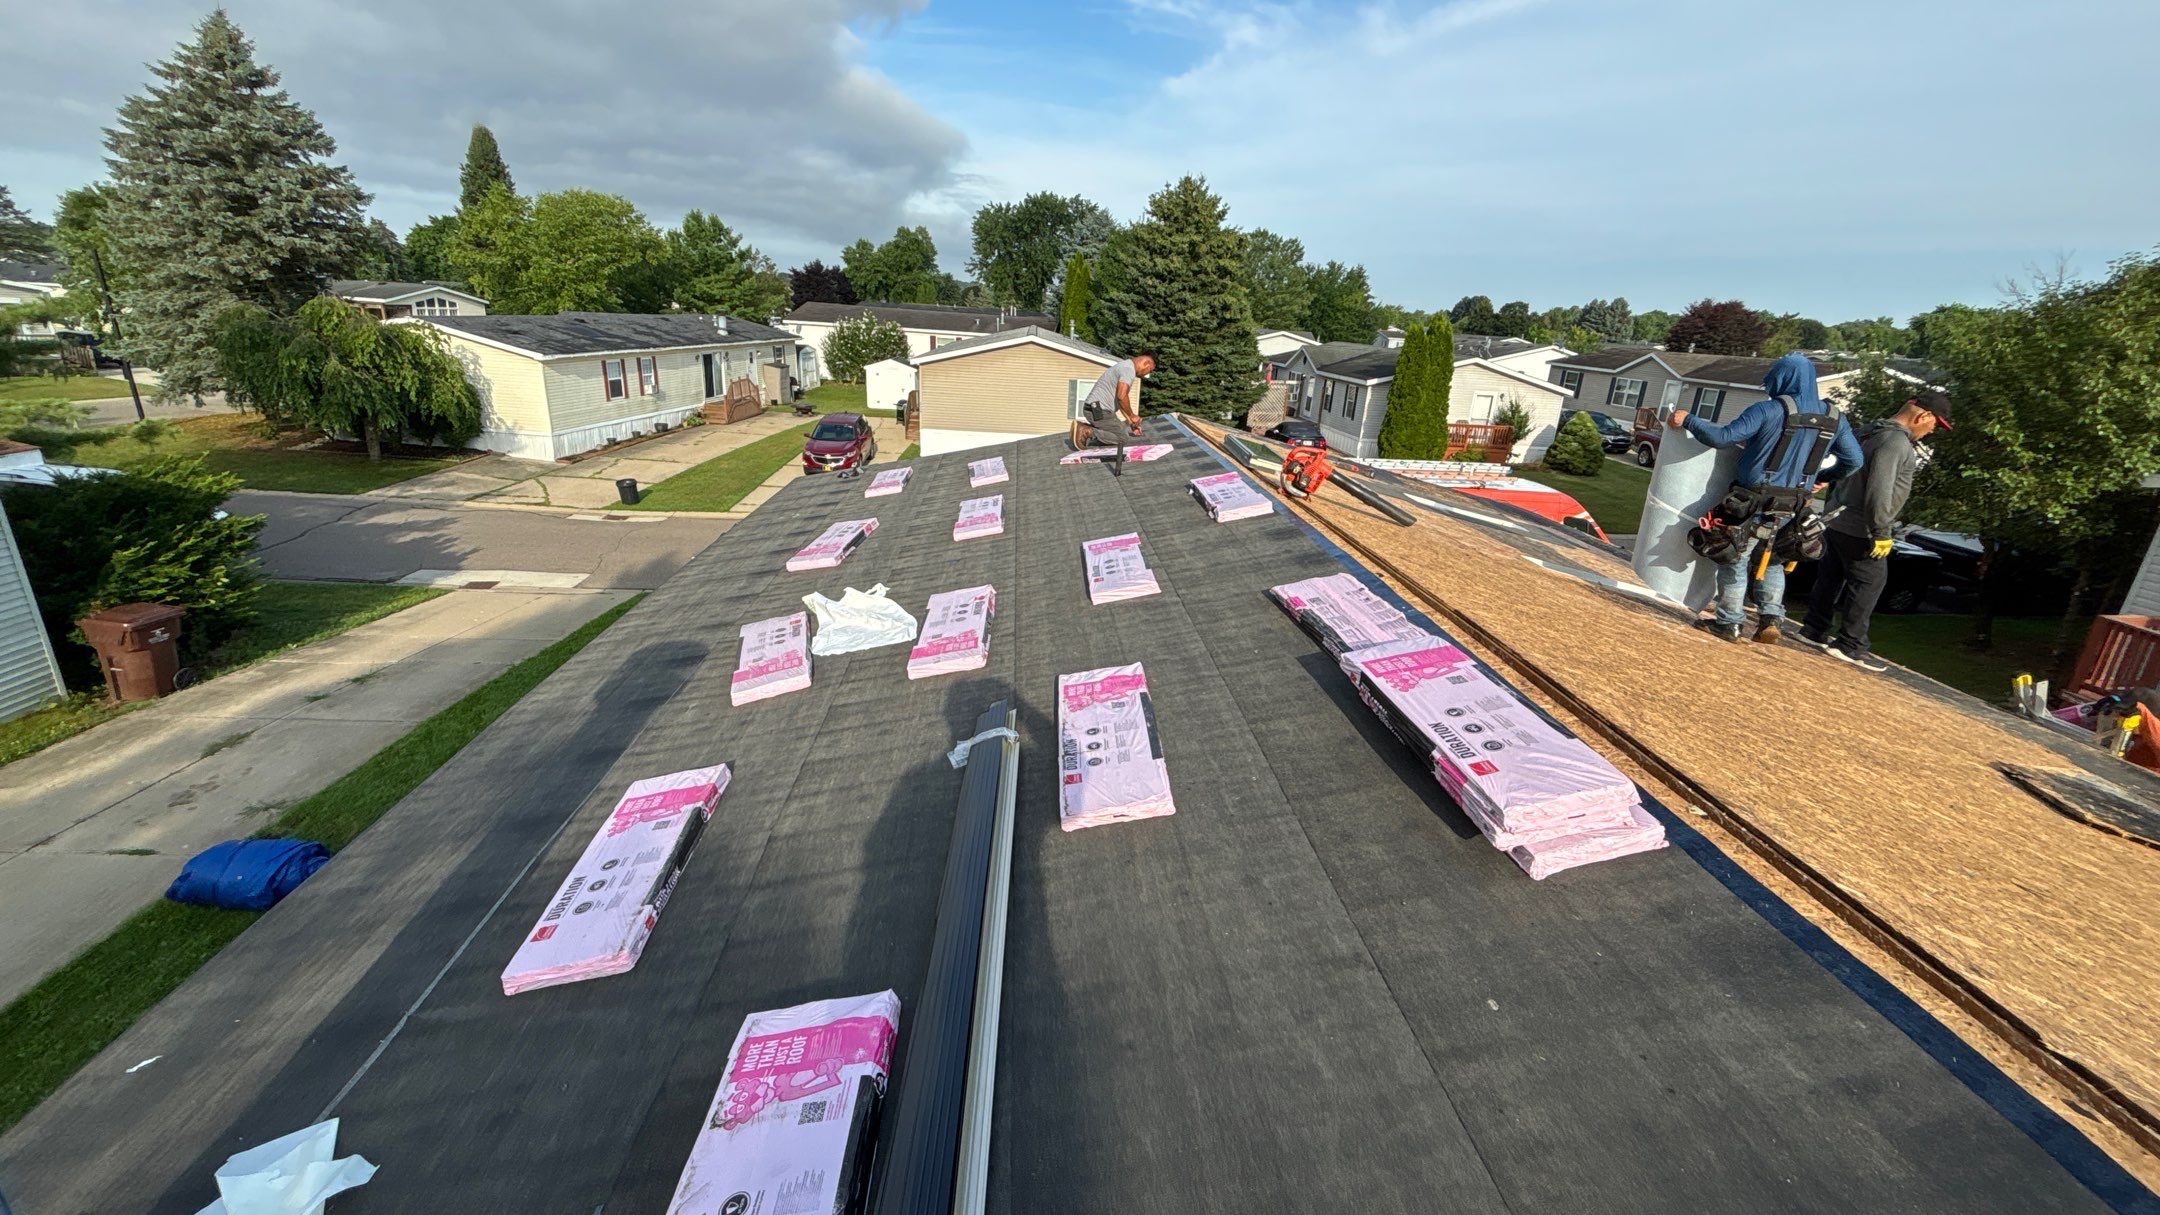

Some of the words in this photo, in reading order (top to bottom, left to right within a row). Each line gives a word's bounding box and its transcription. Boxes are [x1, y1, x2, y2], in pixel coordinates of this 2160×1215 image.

[1065, 738, 1078, 770] DURATION
[1427, 722, 1477, 759] DURATION
[546, 876, 588, 921] DURATION
[741, 1041, 765, 1072] MORE
[757, 1039, 780, 1070] THAN
[773, 1045, 790, 1066] JUST
[786, 1034, 808, 1065] ROOF
